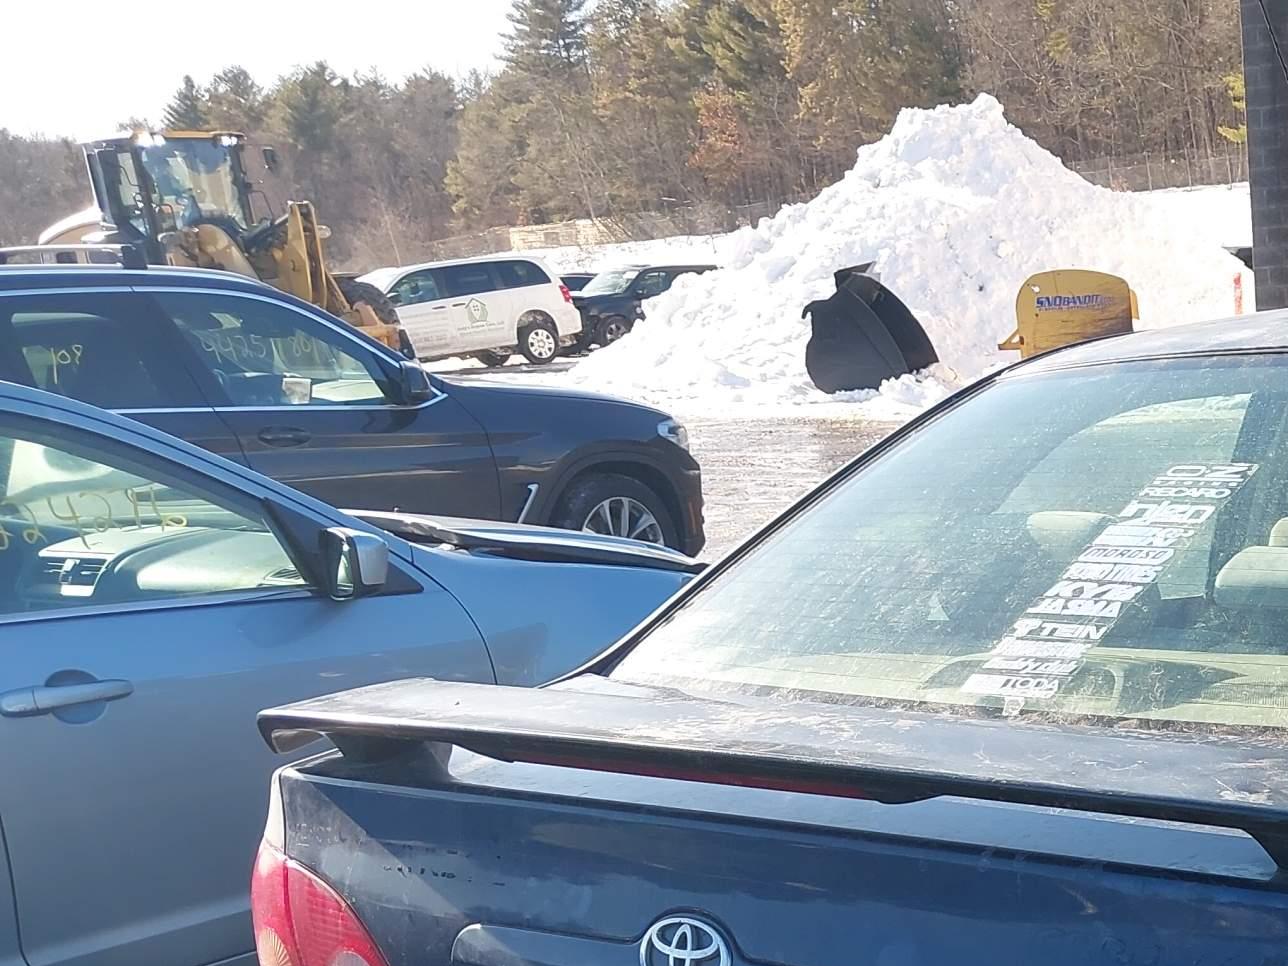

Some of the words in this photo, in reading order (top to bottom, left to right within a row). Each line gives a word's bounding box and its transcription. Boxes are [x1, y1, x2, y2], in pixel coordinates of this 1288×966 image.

[1138, 487, 1231, 499] RECARO
[1041, 622, 1109, 638] TEIN
[1004, 676, 1062, 688] TODA
